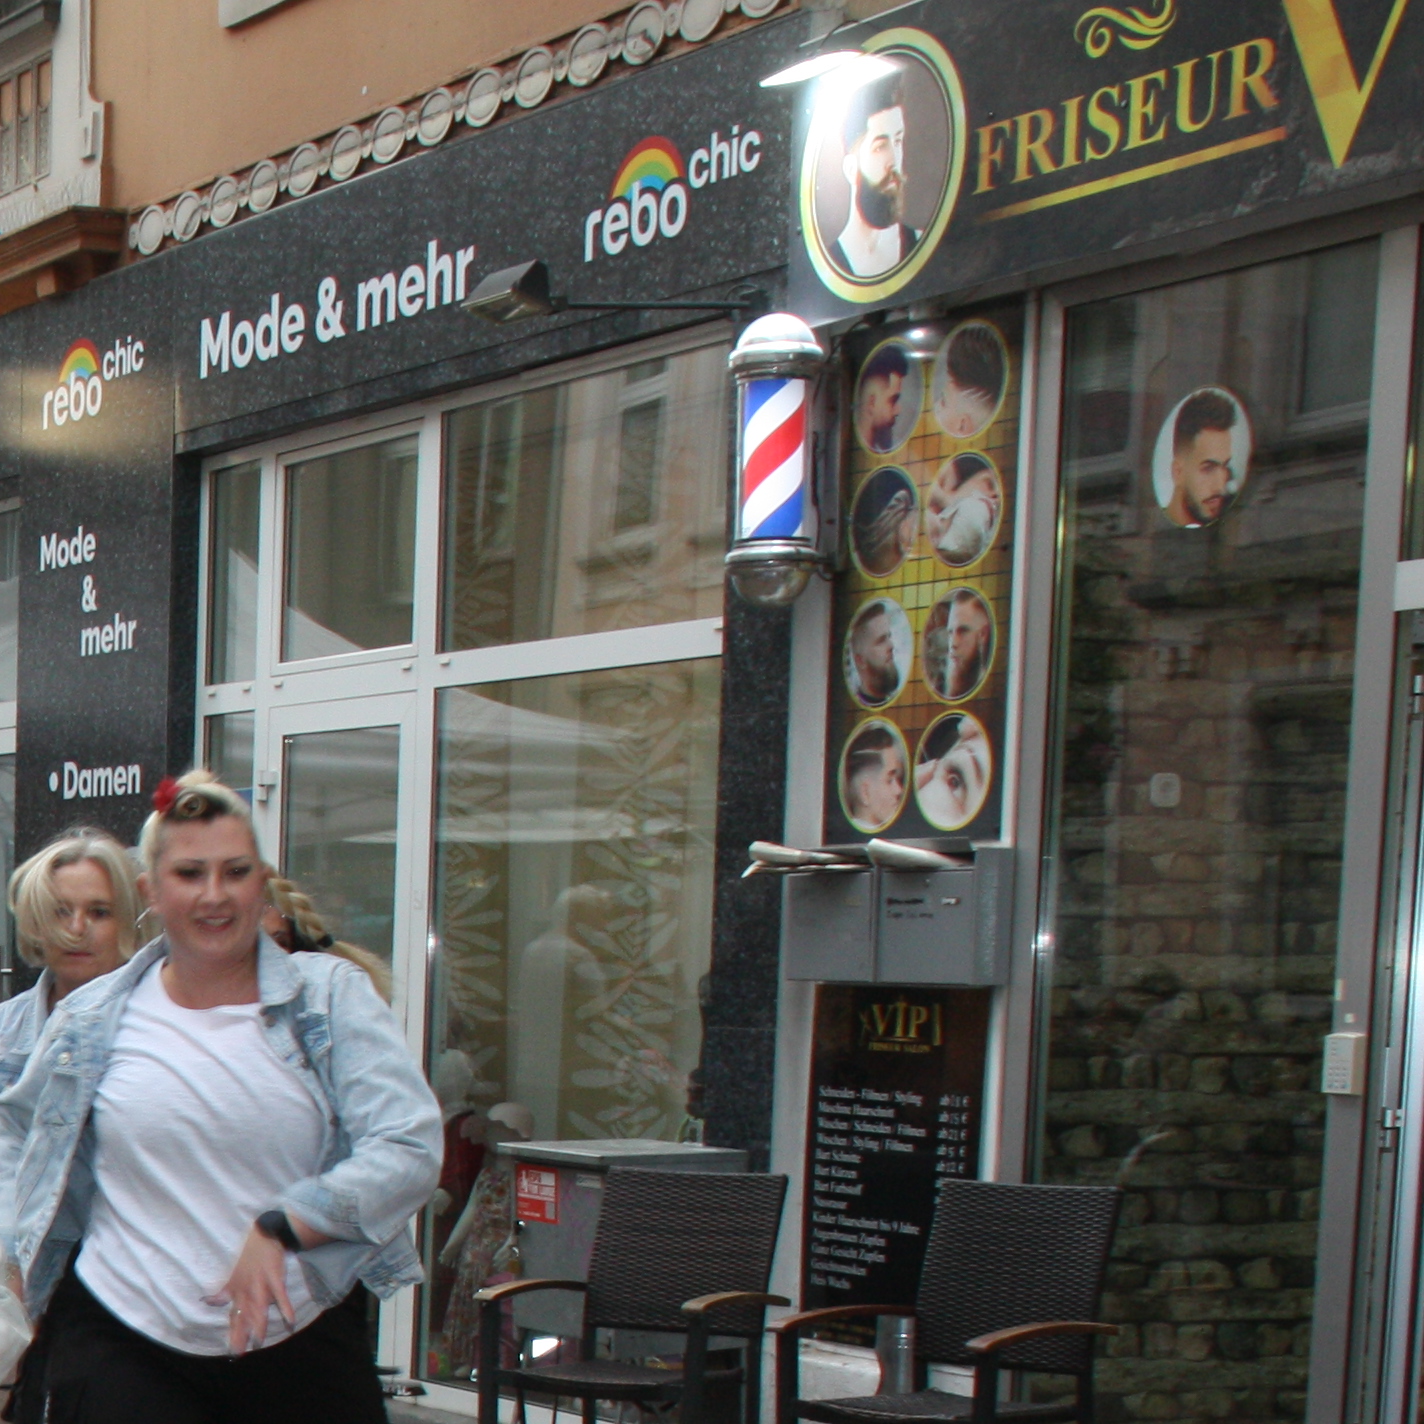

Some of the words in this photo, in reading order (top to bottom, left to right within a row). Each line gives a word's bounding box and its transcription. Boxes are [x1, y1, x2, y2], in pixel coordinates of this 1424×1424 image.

[972, 38, 1284, 195] FRISEUR
[584, 181, 687, 262] rebo
[688, 126, 760, 190] chic
[199, 293, 304, 379] Mode
[315, 276, 345, 343] &
[357, 240, 475, 331] mehr
[42, 369, 102, 430] rebo
[102, 335, 145, 380] chic
[40, 526, 96, 572] Mode
[81, 574, 98, 612] &
[80, 613, 137, 657] mehr
[63, 761, 141, 799] Damen
[871, 1002, 929, 1038] VIP
